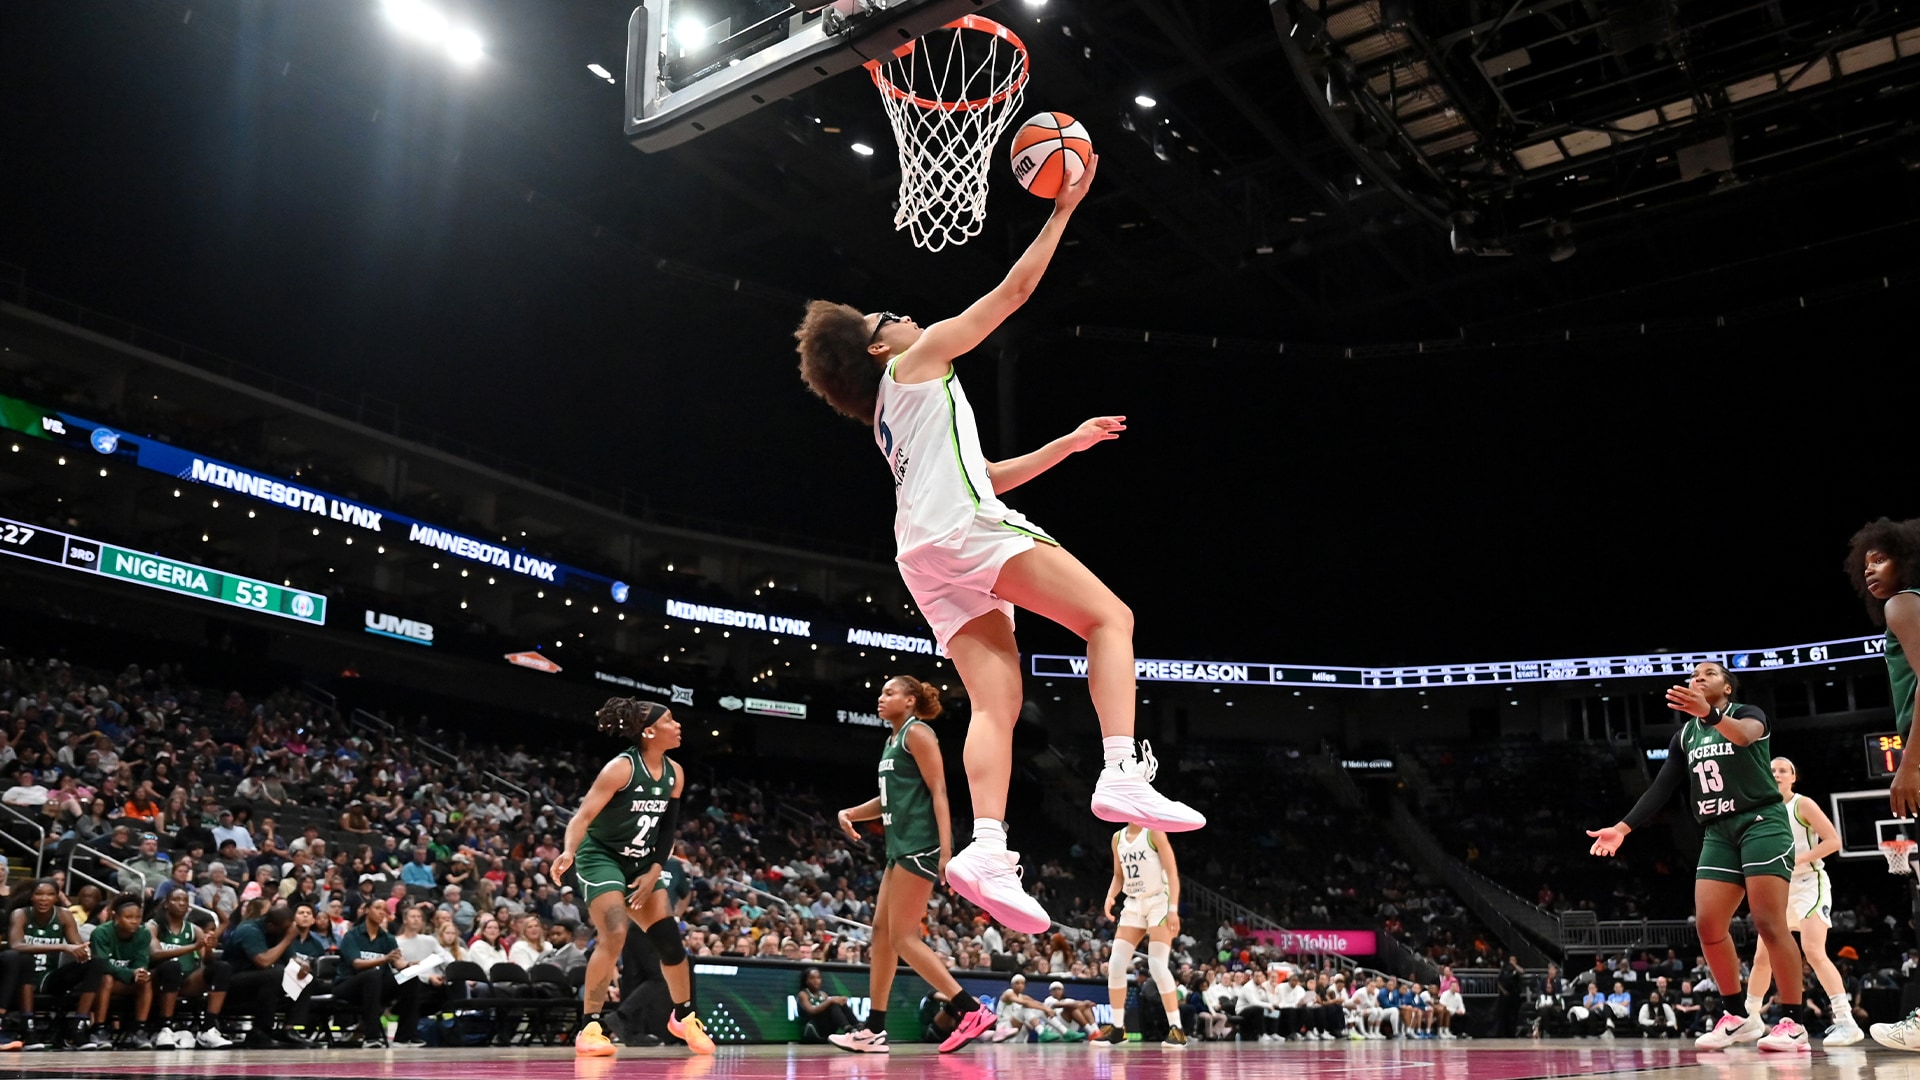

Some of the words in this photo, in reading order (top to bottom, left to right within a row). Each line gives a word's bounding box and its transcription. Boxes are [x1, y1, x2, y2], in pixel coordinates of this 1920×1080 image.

[1014, 155, 1036, 181] Wil
[191, 458, 327, 517] MINNESOTA
[330, 498, 382, 532] LYNX
[69, 546, 96, 563] 3RD
[409, 523, 511, 570] MINNESOTA
[513, 554, 557, 582] LYNX
[115, 552, 209, 592] NIGERIA
[235, 580, 269, 608] 53
[365, 609, 435, 641] UMB
[666, 599, 767, 632] MINNESOTA
[769, 616, 811, 638] LYNX
[847, 628, 933, 655] MINNESOTA
[1863, 639, 1887, 654] LY
[1809, 645, 1828, 662] 61
[1135, 661, 1248, 681] PRESEASON
[1312, 671, 1337, 682] Miles
[1547, 667, 1578, 679] 20/37
[848, 712, 883, 727] Mobile
[1879, 735, 1903, 751] 3:2
[1646, 748, 1669, 760] UM
[1688, 742, 1735, 765] NGERIA
[1692, 759, 1724, 794] 13
[630, 800, 669, 813] NIGER
[1120, 850, 1148, 866] YNX
[1125, 864, 1141, 879] 12
[1296, 934, 1348, 952] Mobile
